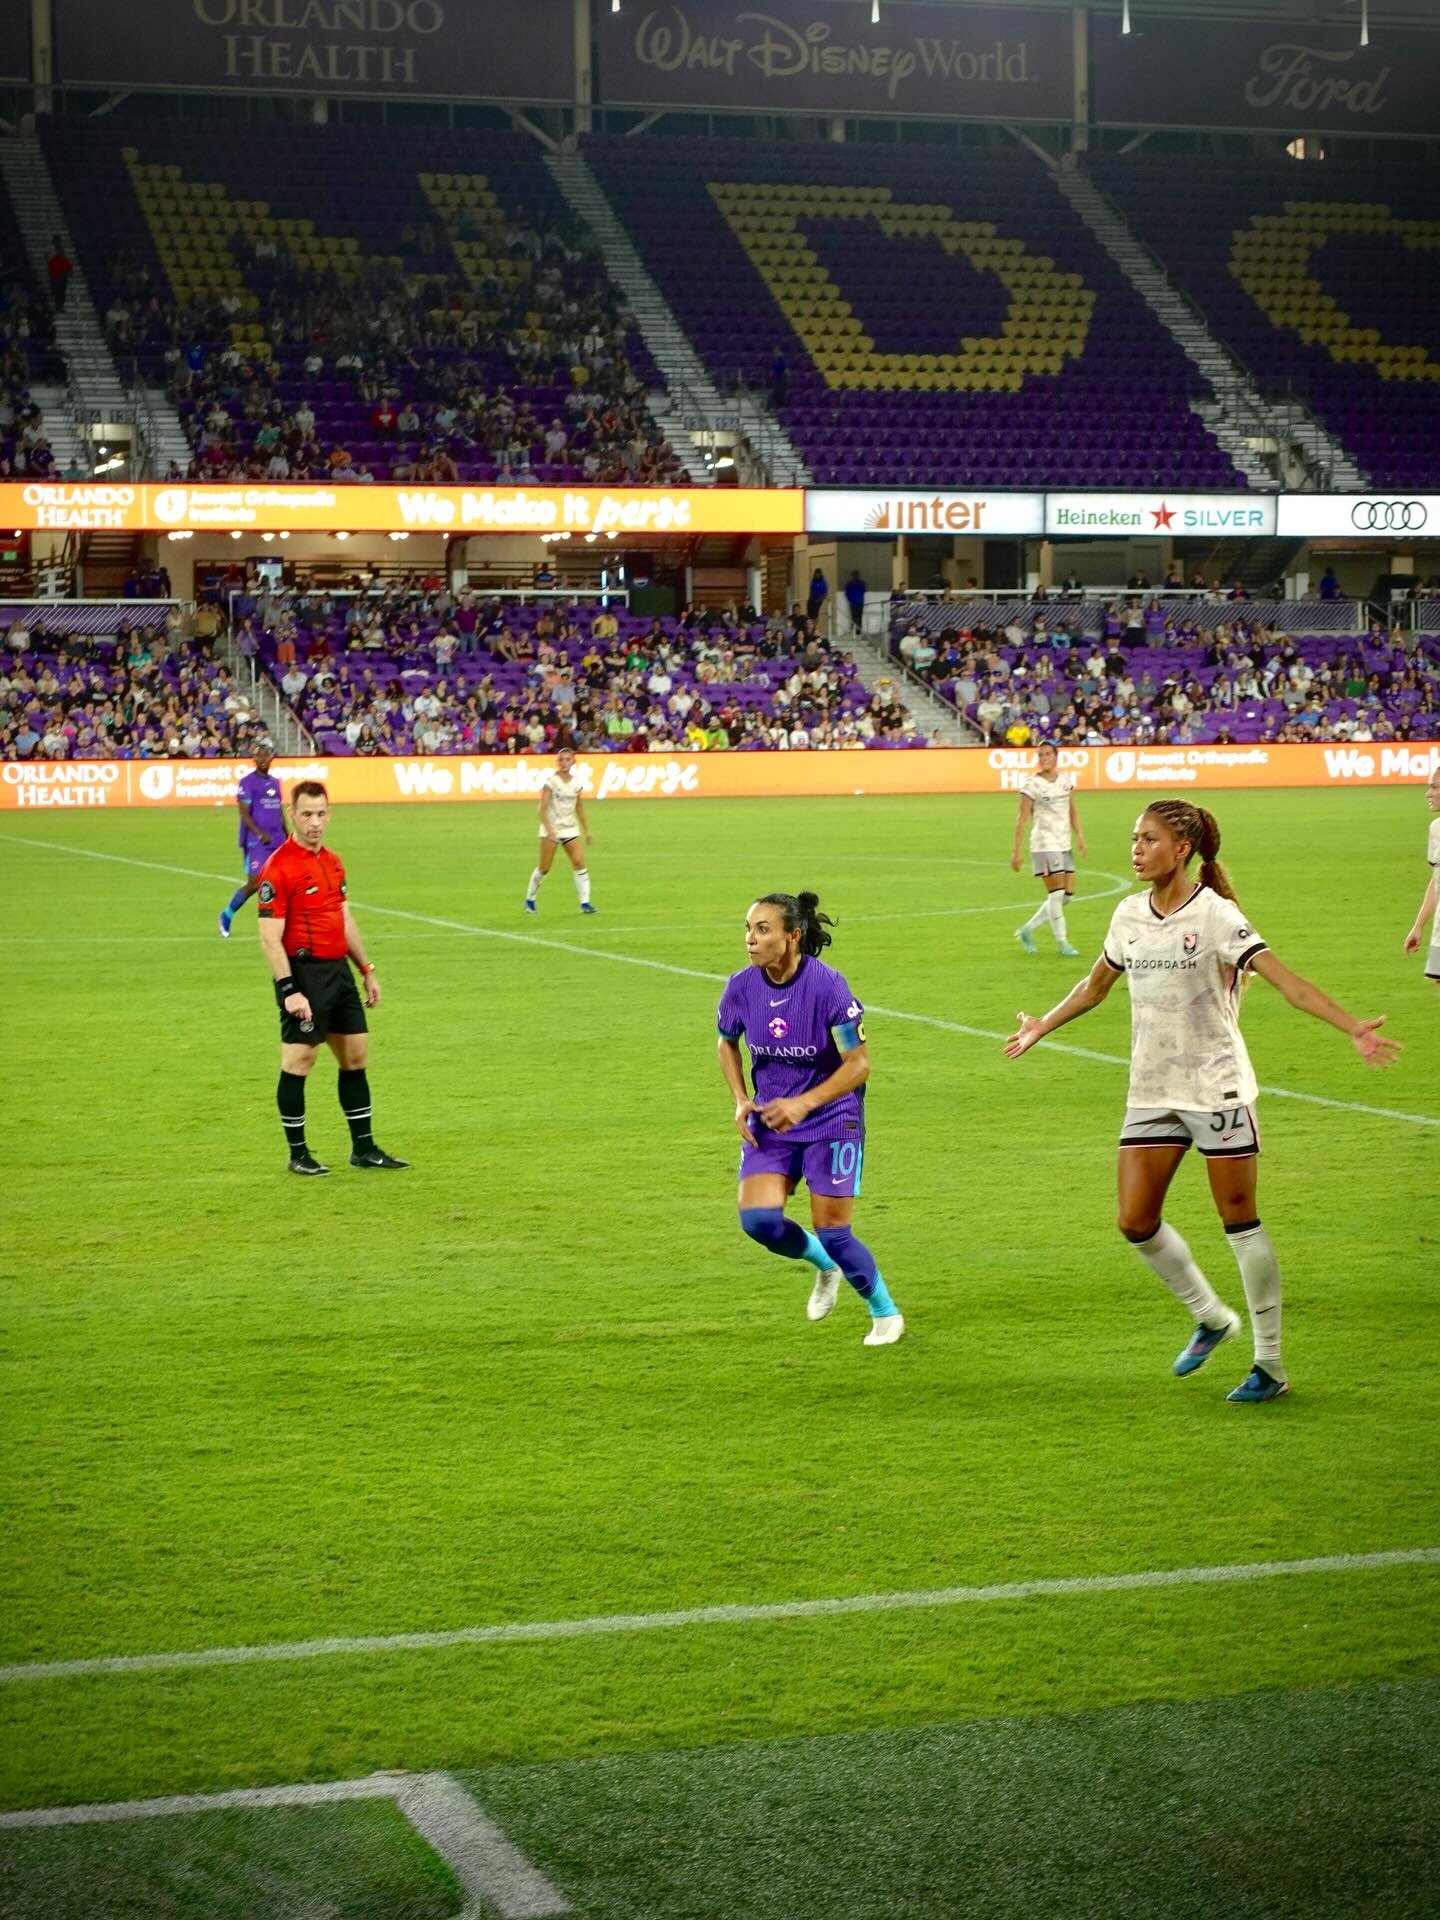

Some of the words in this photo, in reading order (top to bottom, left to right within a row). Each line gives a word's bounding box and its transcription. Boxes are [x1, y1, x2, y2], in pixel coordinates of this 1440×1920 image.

[223, 35, 417, 82] HEALTH
[1245, 43, 1391, 113] Ford
[24, 485, 134, 506] ORLANDO
[37, 506, 124, 527] HEALTH
[398, 493, 454, 524] We
[462, 493, 557, 525] Make
[1057, 508, 1141, 525] Heineken
[1184, 510, 1263, 526] SILVER
[3, 763, 118, 784] ORLANDO
[1324, 749, 1375, 777] We
[393, 763, 453, 794] We
[17, 785, 105, 806] HEALTH
[1135, 960, 1197, 970] DOORDASH
[749, 1044, 817, 1057] ORLANDO
[830, 1142, 856, 1175] 10
